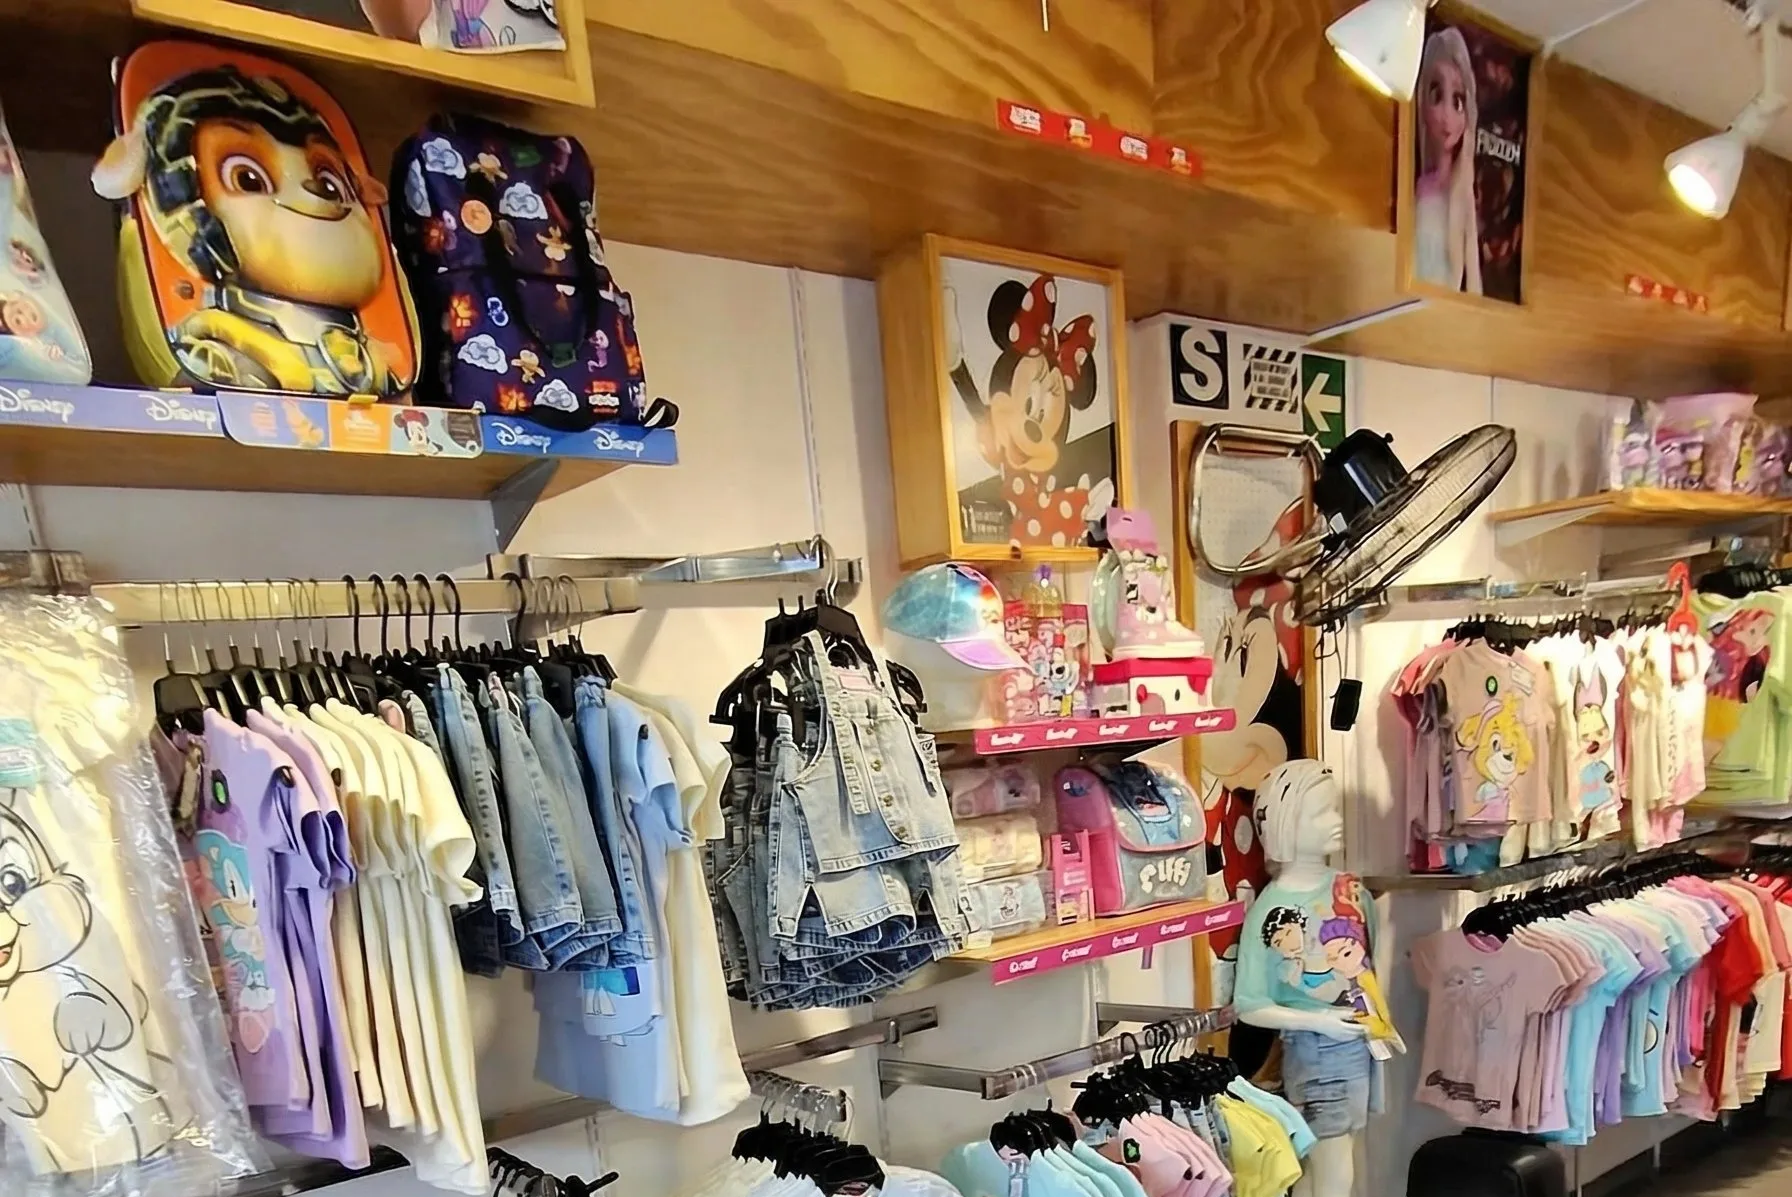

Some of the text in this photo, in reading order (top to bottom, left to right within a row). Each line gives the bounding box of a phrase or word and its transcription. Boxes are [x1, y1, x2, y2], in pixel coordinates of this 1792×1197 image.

[1180, 325, 1223, 402] S
[0, 385, 75, 424] Disney
[138, 393, 217, 430] Disney
[491, 421, 552, 454] Disney
[592, 426, 645, 458] Disney
